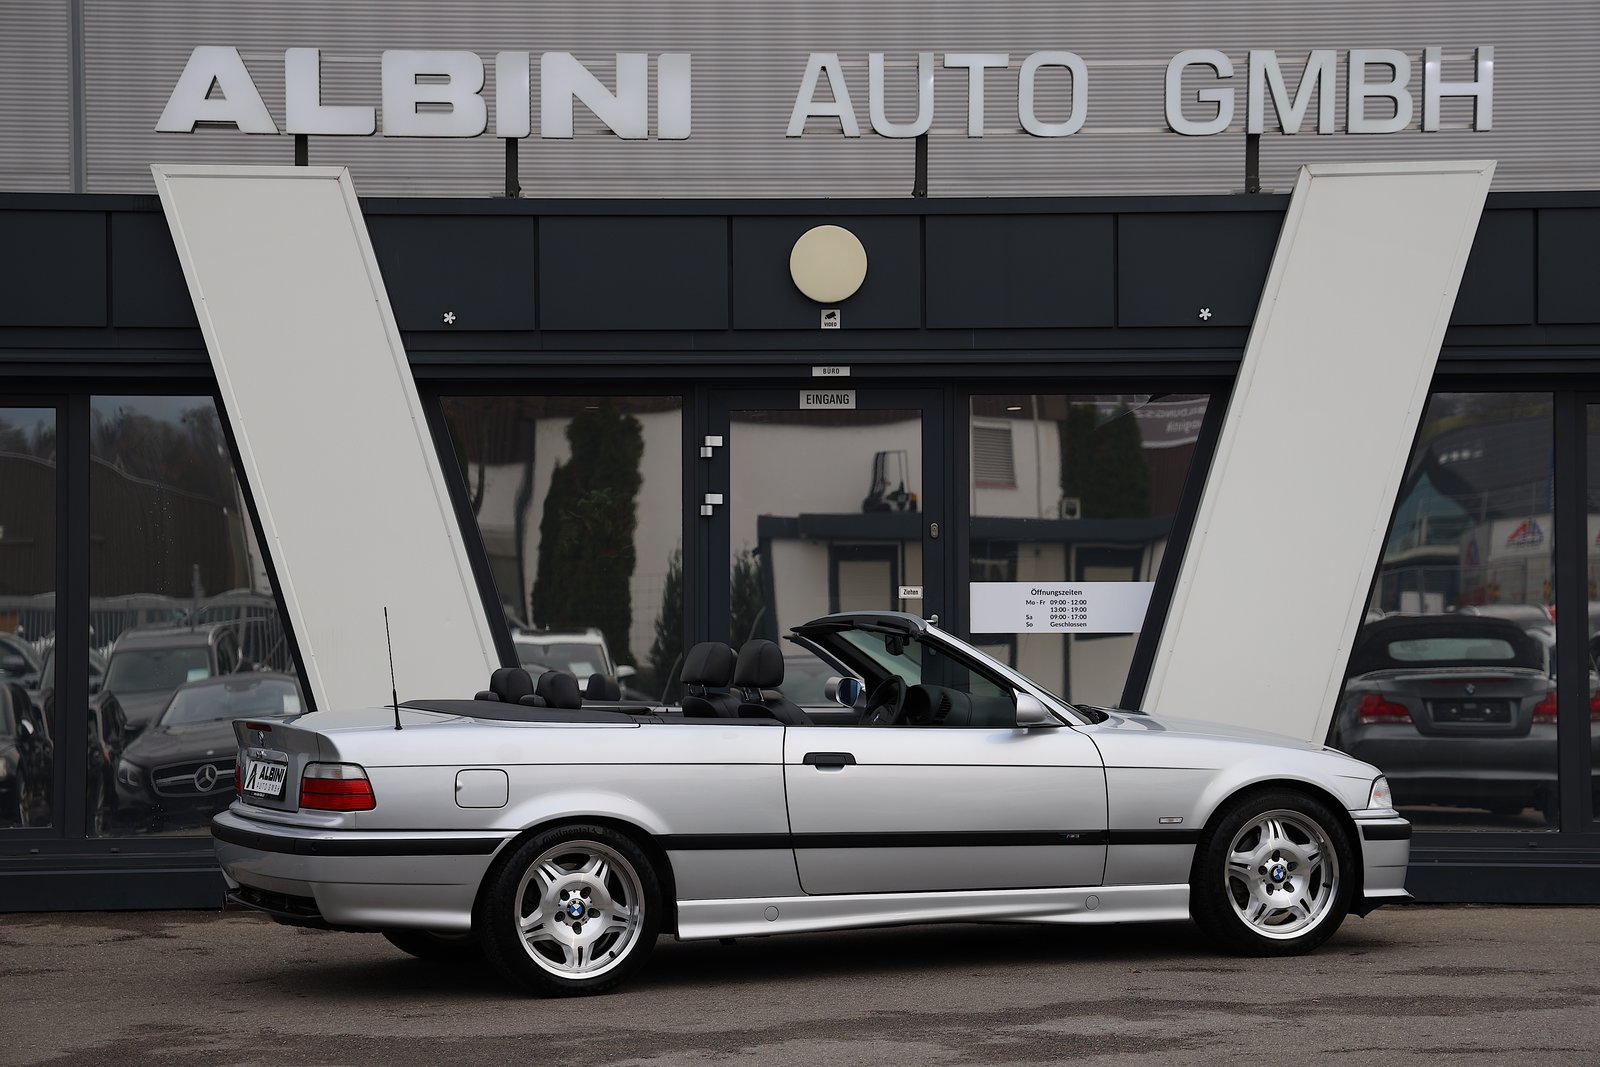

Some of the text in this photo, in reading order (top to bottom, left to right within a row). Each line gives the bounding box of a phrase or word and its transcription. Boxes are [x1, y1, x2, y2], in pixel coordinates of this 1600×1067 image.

[154, 46, 1494, 140] ALBINI AUTO GMBH
[806, 394, 850, 404] EINGANG
[1030, 588, 1082, 596] Öffnungszeiten
[259, 766, 285, 782] ALBINI
